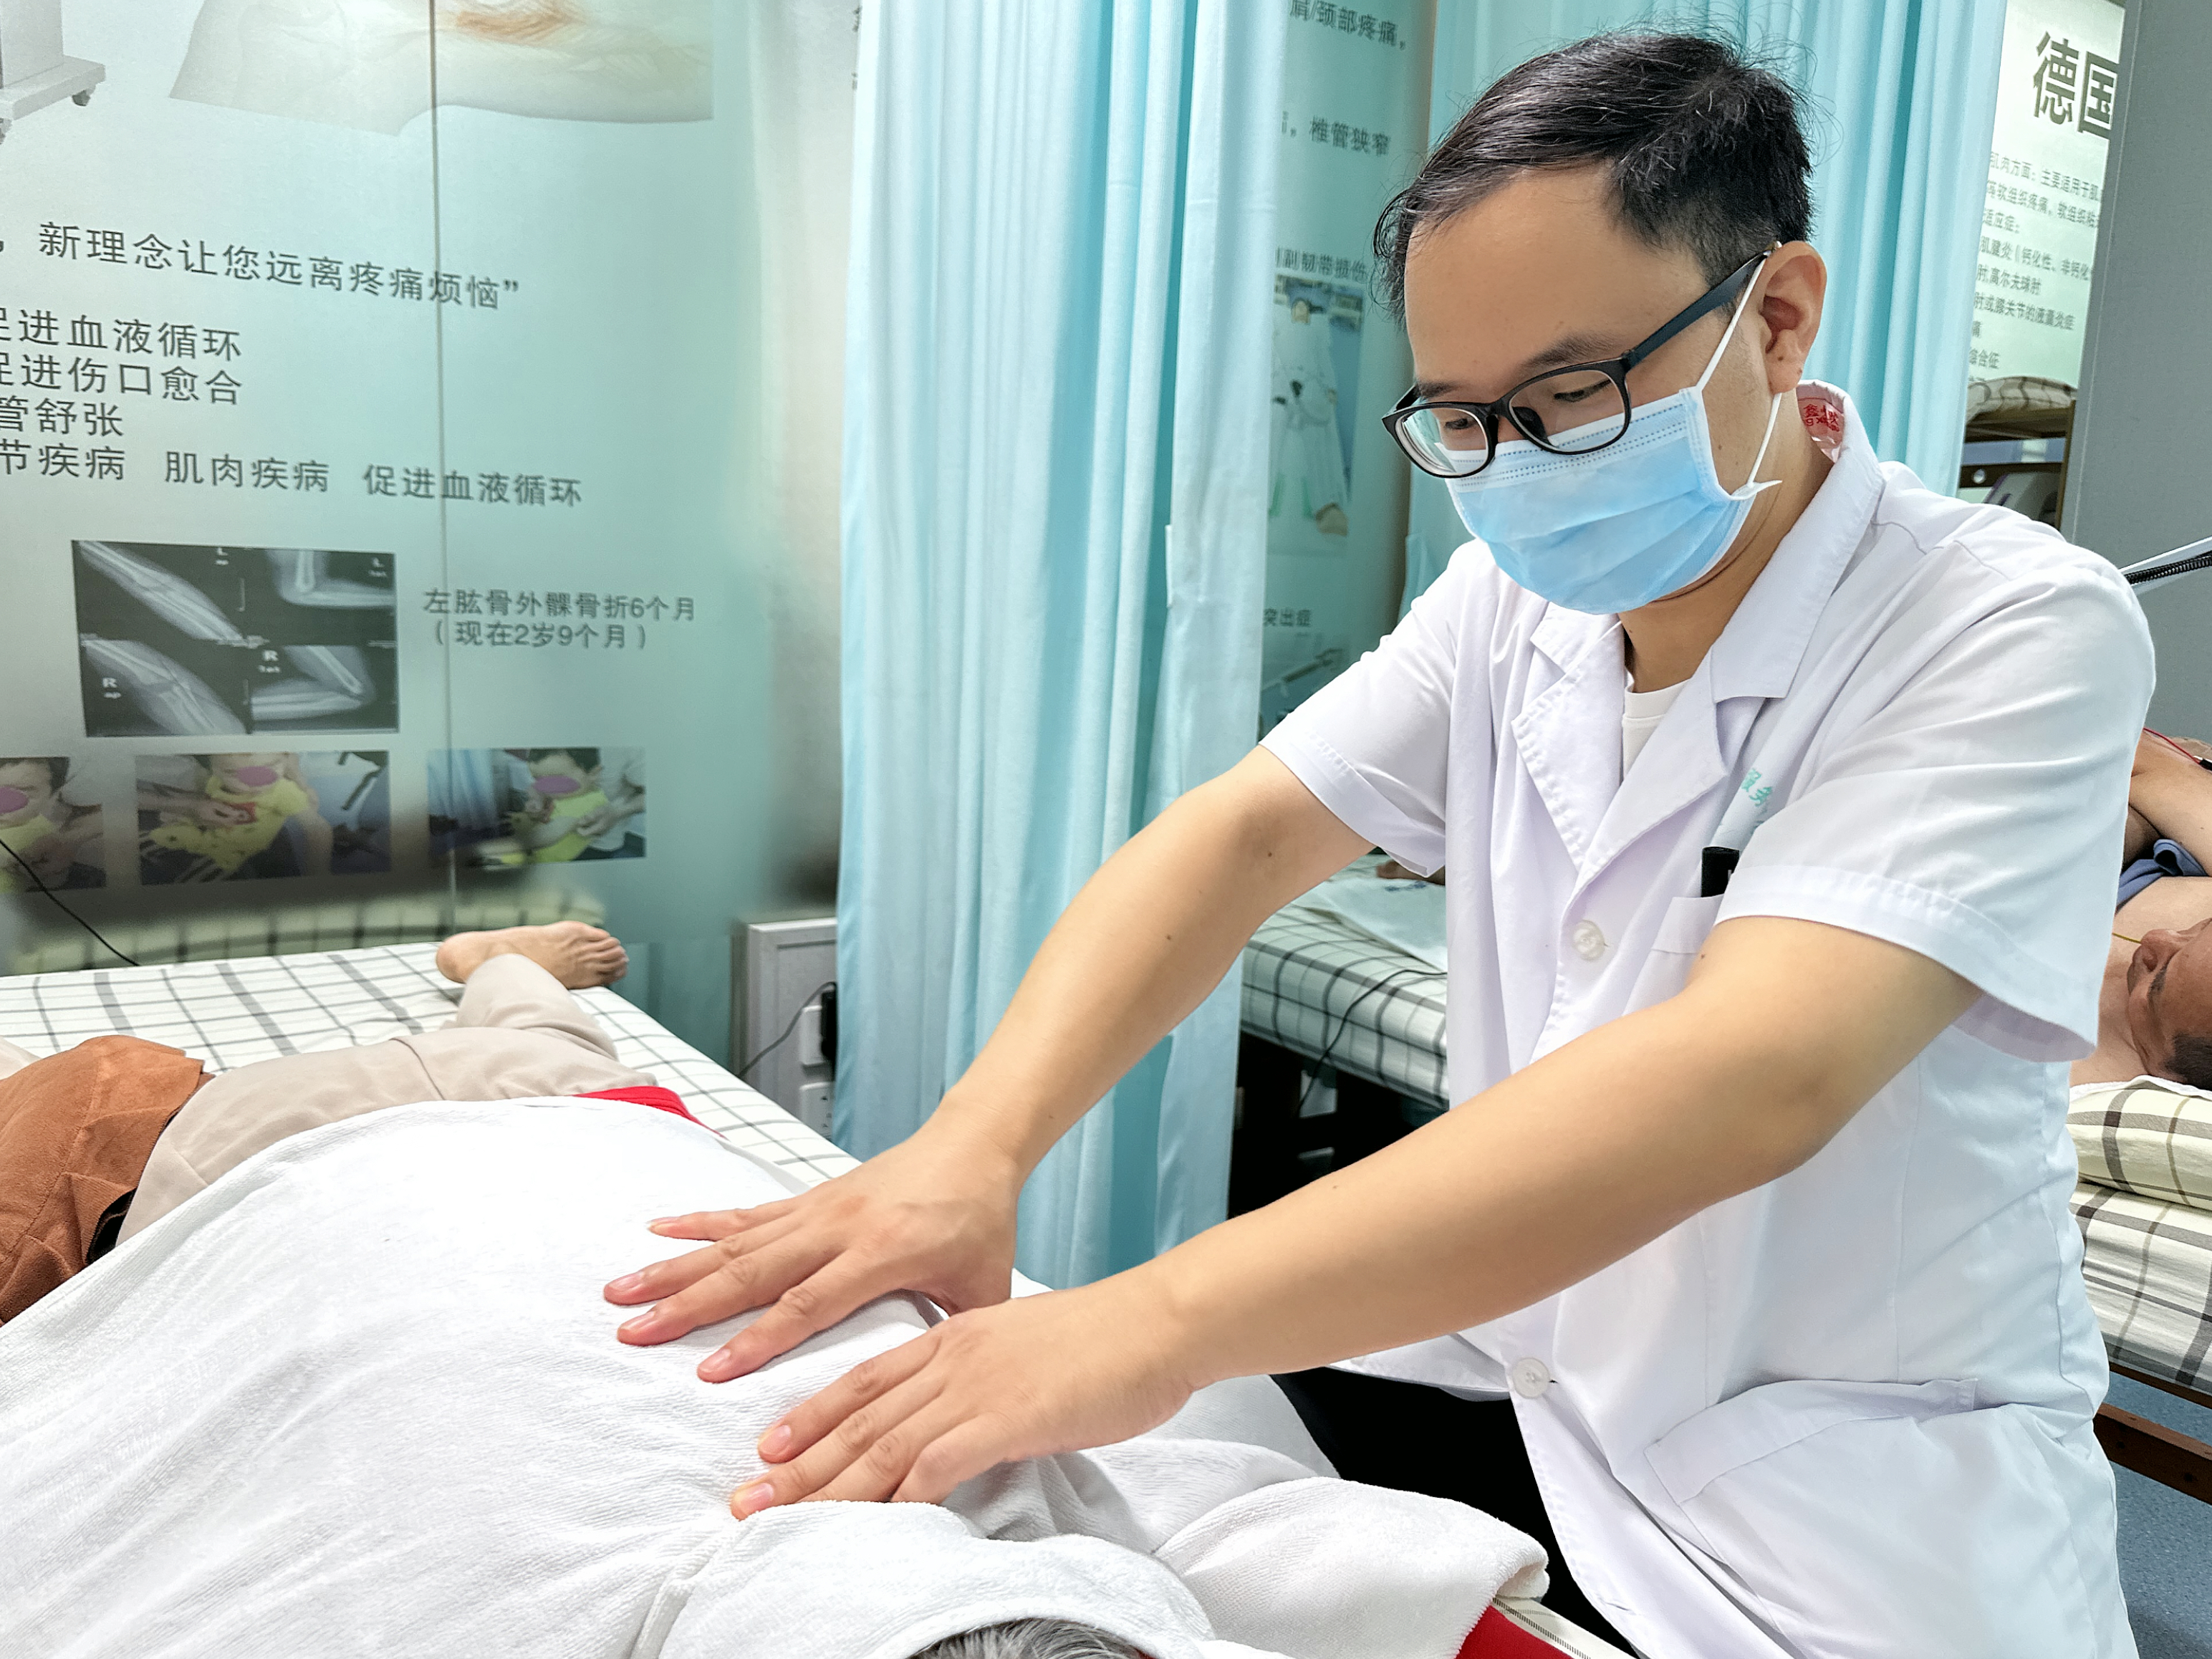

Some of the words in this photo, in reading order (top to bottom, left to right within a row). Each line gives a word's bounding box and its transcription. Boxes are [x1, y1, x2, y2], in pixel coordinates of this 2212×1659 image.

[2033, 31, 2120, 140] 德国
[1275, 247, 1369, 284] 副韧带损伤
[0, 395, 124, 436] 管舒张
[0, 438, 125, 480] 节疾病
[165, 451, 330, 493] 肌肉疾病
[362, 463, 582, 506] 促进血液循环
[423, 587, 695, 622] 左肱骨外髁骨折6个月
